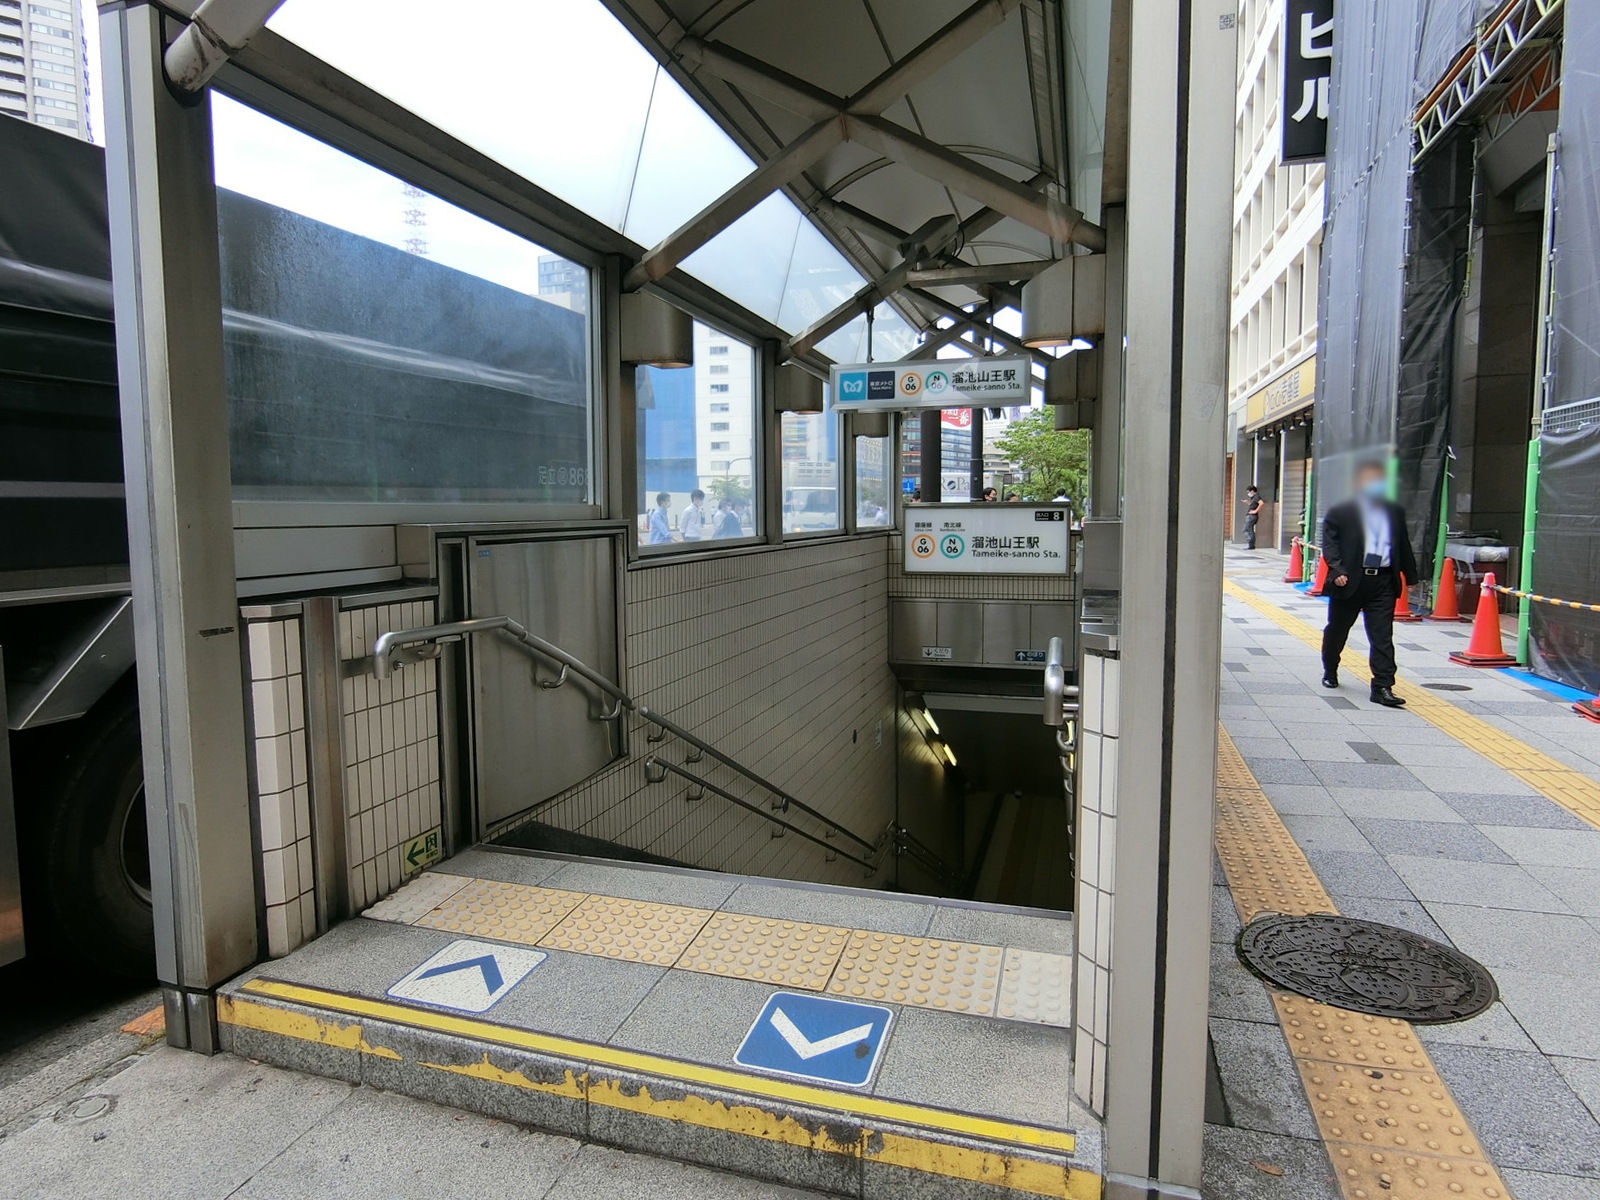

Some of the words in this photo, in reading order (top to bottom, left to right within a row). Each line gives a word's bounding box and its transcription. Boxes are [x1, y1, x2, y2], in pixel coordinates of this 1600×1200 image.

[952, 369, 1016, 384] 溜池山王駅
[905, 383, 917, 391] 06
[931, 381, 942, 390] 06
[952, 382, 1006, 392] Tameike-sanno
[1008, 381, 1022, 390] Sta.
[1053, 511, 1060, 520] 8
[971, 535, 1040, 549] 溜池山王駅
[917, 545, 930, 554] 06
[946, 545, 959, 554] 06
[971, 549, 1040, 558] Tameike-sanno
[1043, 549, 1061, 558] Sta.
